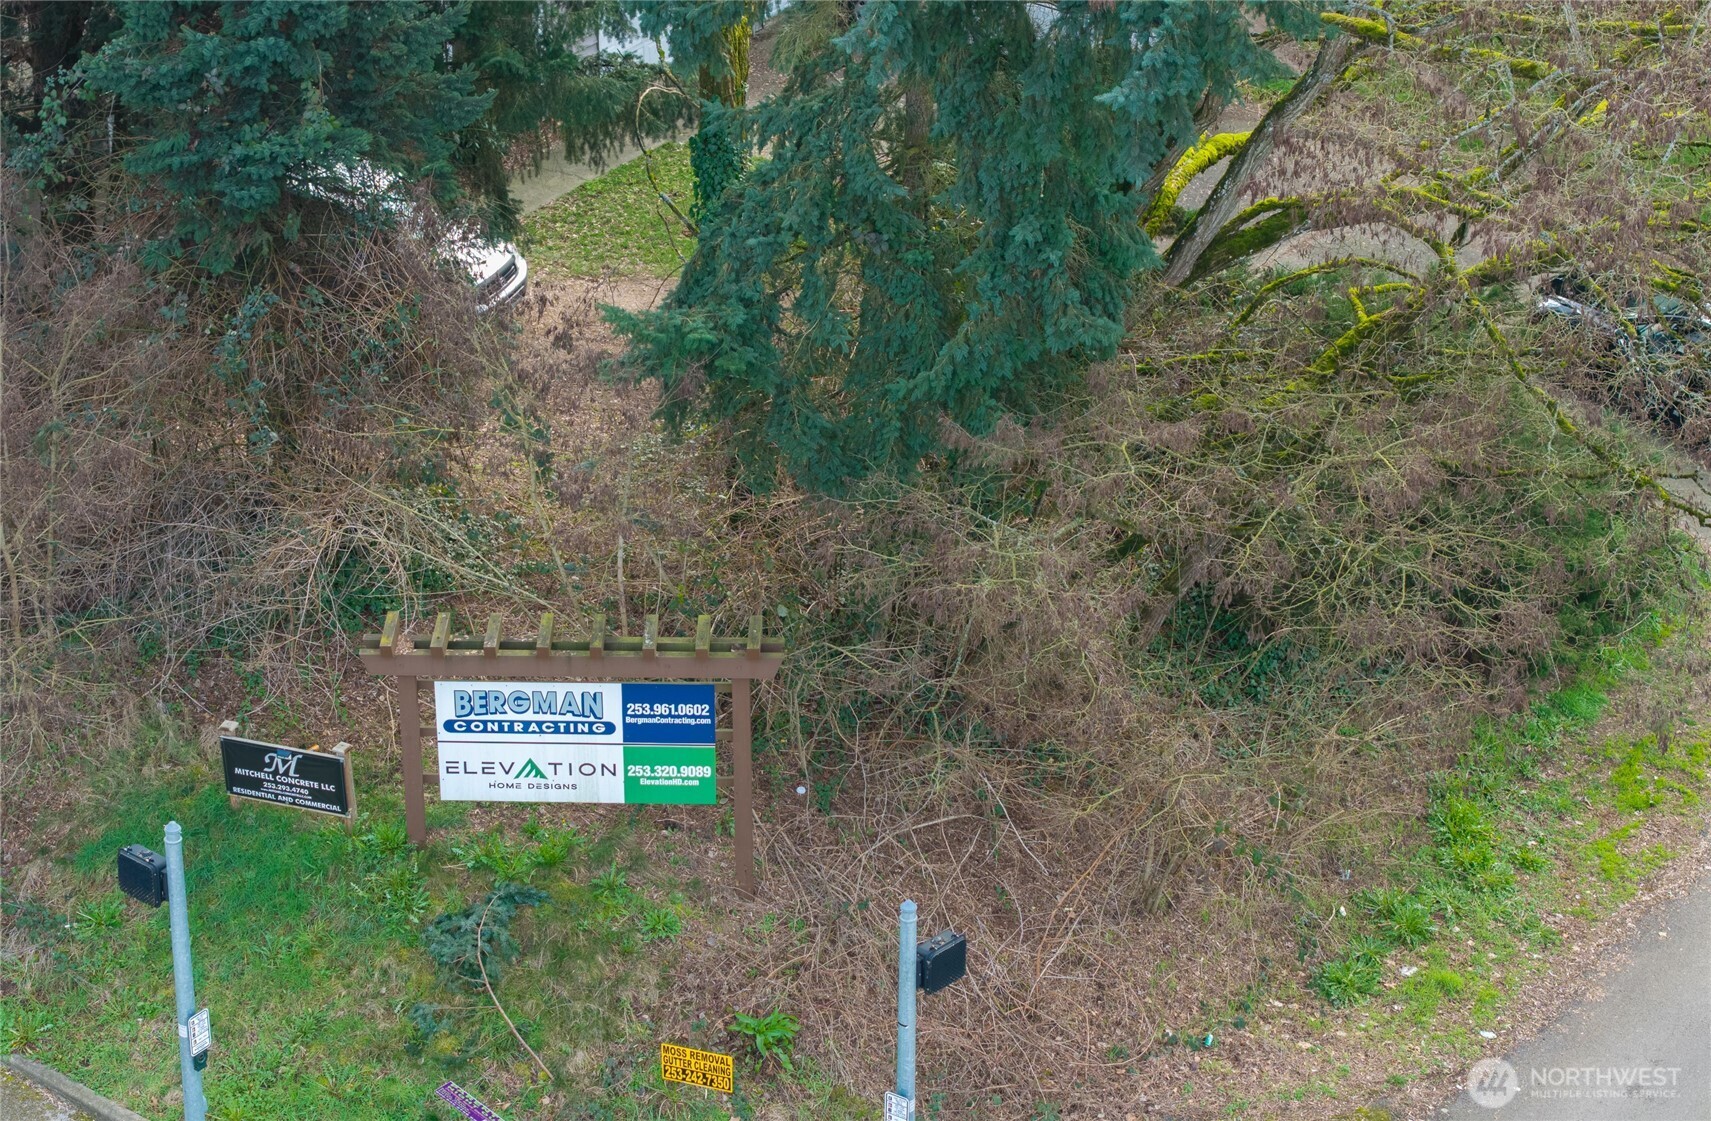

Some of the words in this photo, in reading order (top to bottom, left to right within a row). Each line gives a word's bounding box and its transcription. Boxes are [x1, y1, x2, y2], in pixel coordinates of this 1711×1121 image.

[453, 690, 604, 720] BERGMAN
[626, 703, 710, 716] 253.961.0602
[453, 721, 606, 733] CONTRACTING
[625, 716, 711, 726] BergmanContracting.com
[445, 758, 616, 779] ELEVATION
[627, 765, 711, 778] 253.320.9089
[234, 767, 275, 781] MITCHELL
[276, 775, 319, 789] CONCRETE
[320, 783, 336, 792] LLC
[488, 782, 522, 790] HOME
[527, 782, 578, 790] DESIGNS
[639, 778, 699, 786] ElevationHD.com
[263, 782, 309, 795] 253.293.4740
[232, 787, 276, 800] RESIDENTIAL
[277, 795, 294, 803] AND
[295, 797, 342, 812] COMMERCIAL
[662, 1045, 687, 1058] MOSS
[689, 1050, 731, 1067] REMOVAL
[662, 1055, 692, 1069] GUTTER
[694, 1061, 731, 1077] CLEANING
[665, 1065, 730, 1090] 253-242-7350
